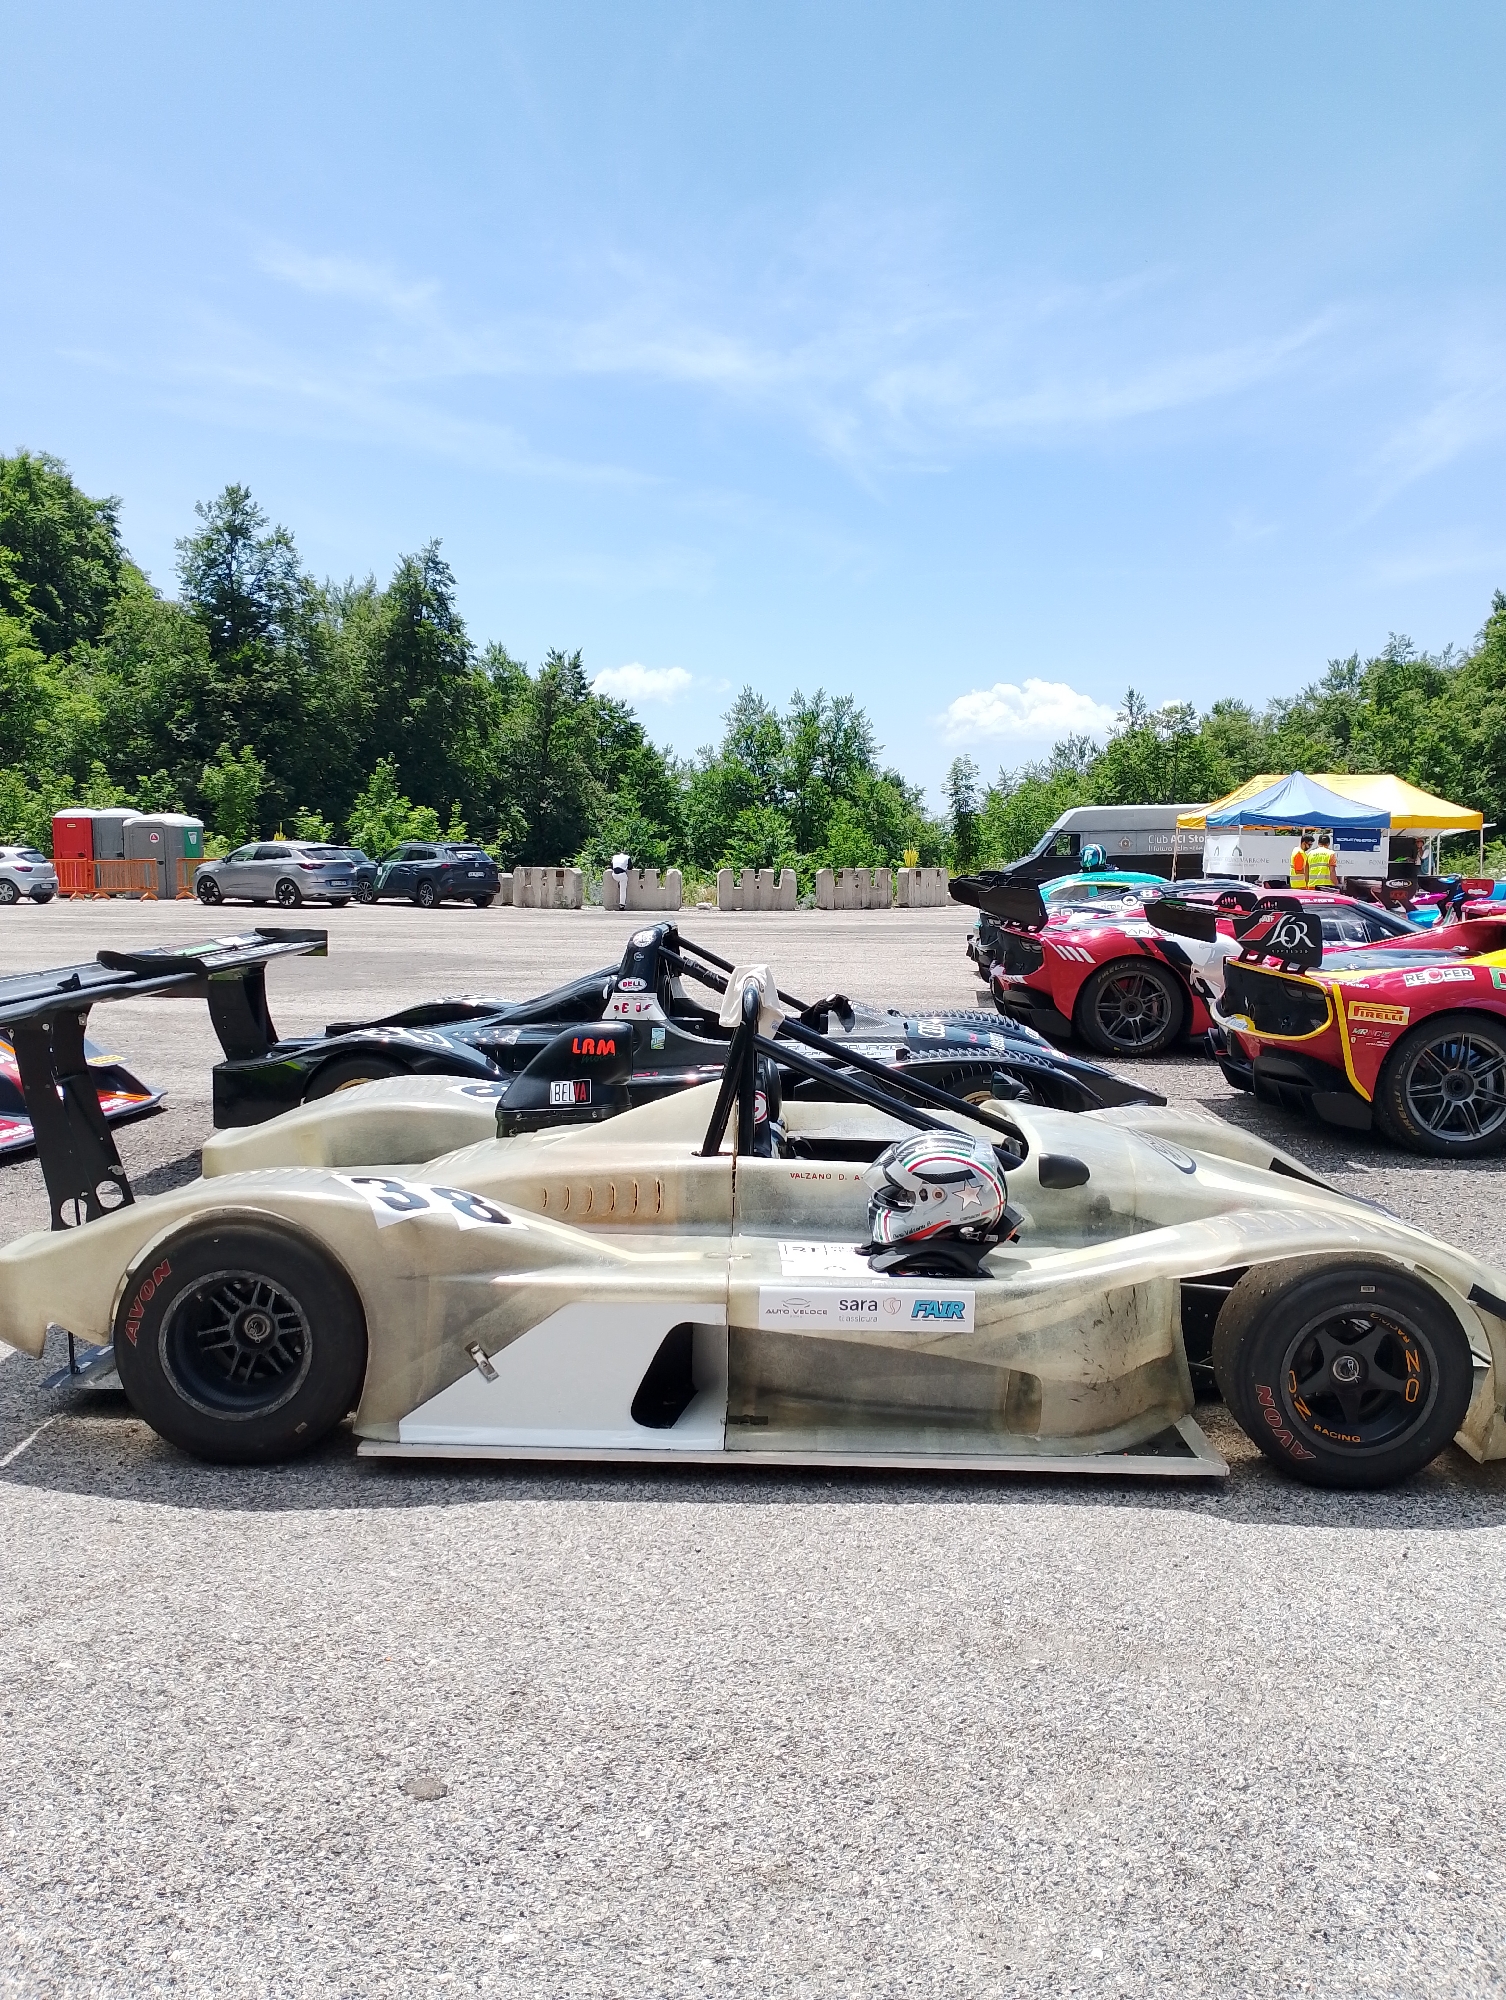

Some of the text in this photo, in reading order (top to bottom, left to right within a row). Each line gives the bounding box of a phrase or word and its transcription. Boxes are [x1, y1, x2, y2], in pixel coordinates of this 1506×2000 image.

[1148, 834, 1205, 844] Club ACI Sto
[1353, 1005, 1405, 1022] PIRELLI
[554, 1082, 588, 1102] BELVA
[789, 1172, 832, 1180] VALZANO
[838, 1173, 848, 1181] D.
[350, 1176, 513, 1225] 38
[124, 1257, 172, 1348] AVON
[793, 1308, 828, 1316] VELOCE
[838, 1299, 878, 1312] sara
[910, 1299, 966, 1320] FAIR
[1255, 1383, 1317, 1460] AVON
[1313, 1423, 1362, 1443] RACING
